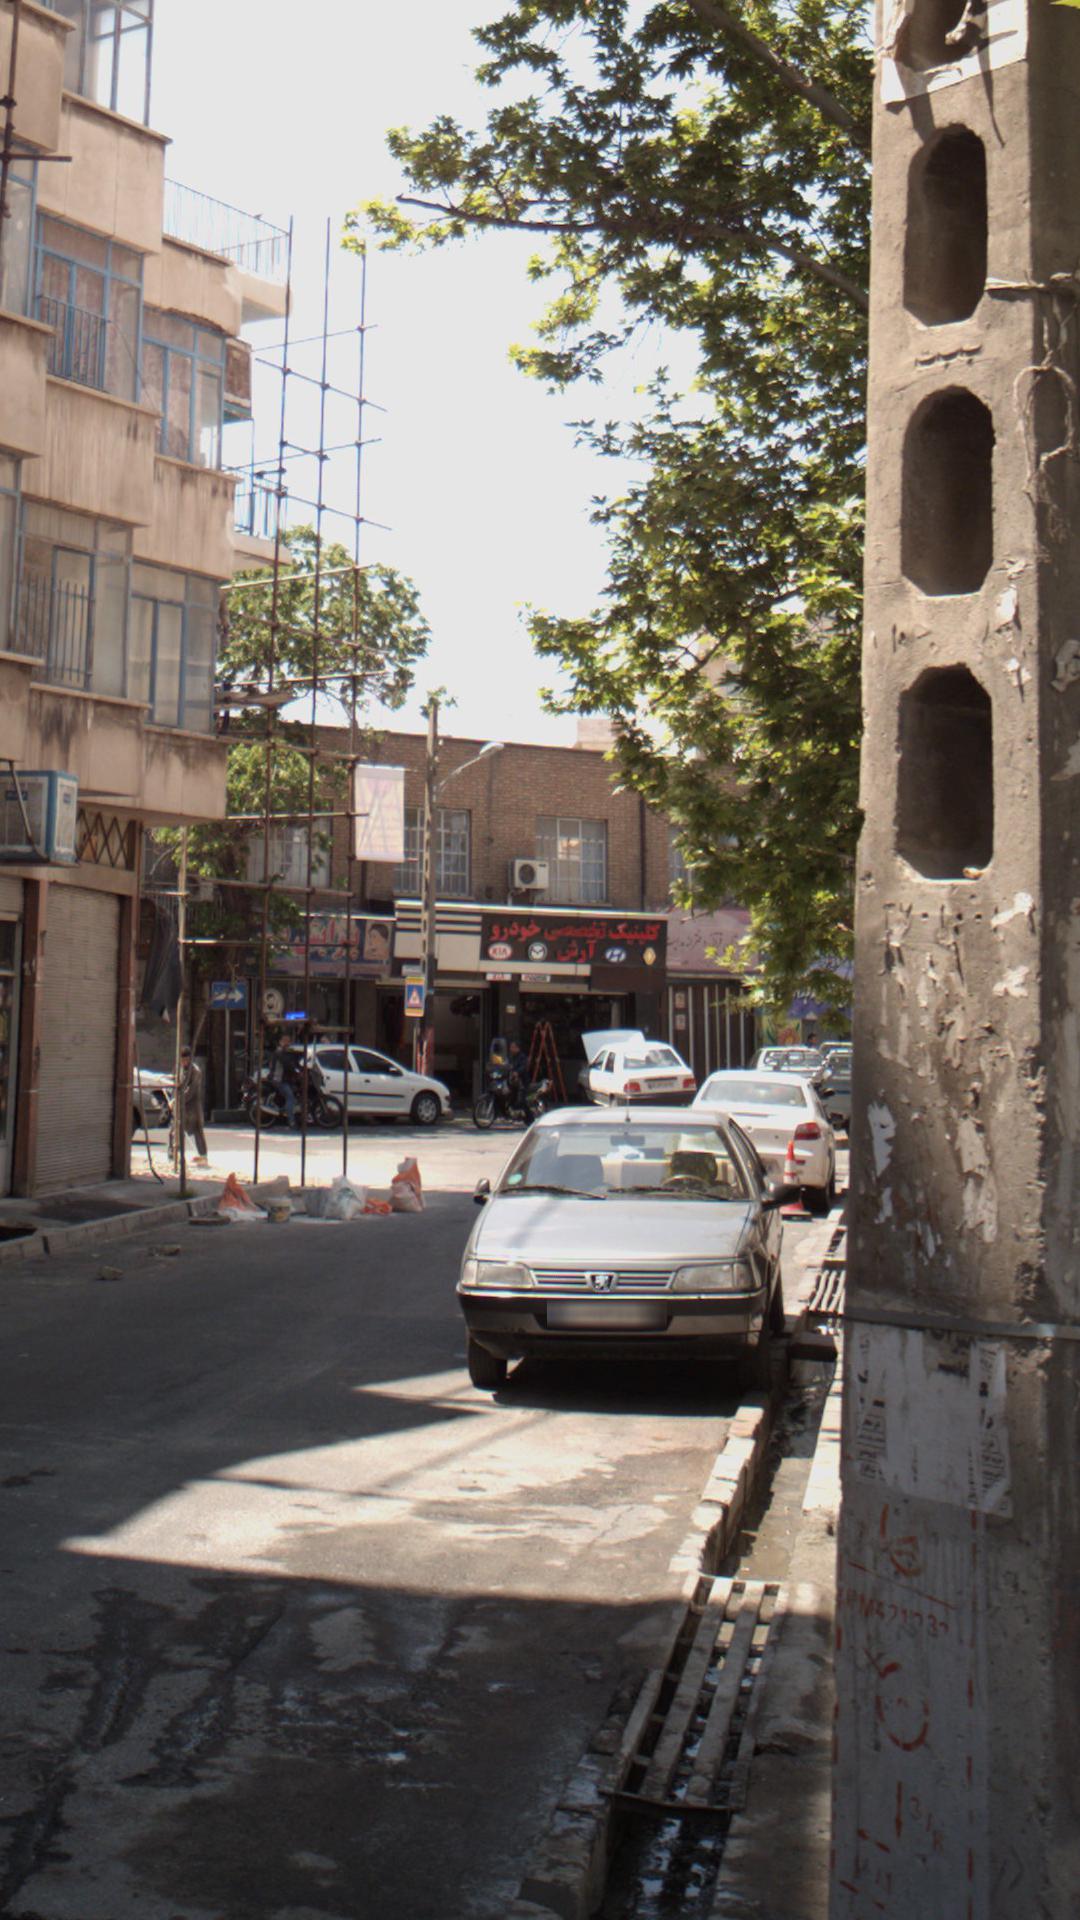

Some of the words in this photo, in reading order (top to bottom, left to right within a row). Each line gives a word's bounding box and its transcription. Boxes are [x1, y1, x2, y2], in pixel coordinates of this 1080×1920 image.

[489, 919, 541, 942] خودرو
[543, 921, 608, 941] تخصصی
[608, 922, 661, 944] کلینیک
[556, 940, 597, 963] آرش
